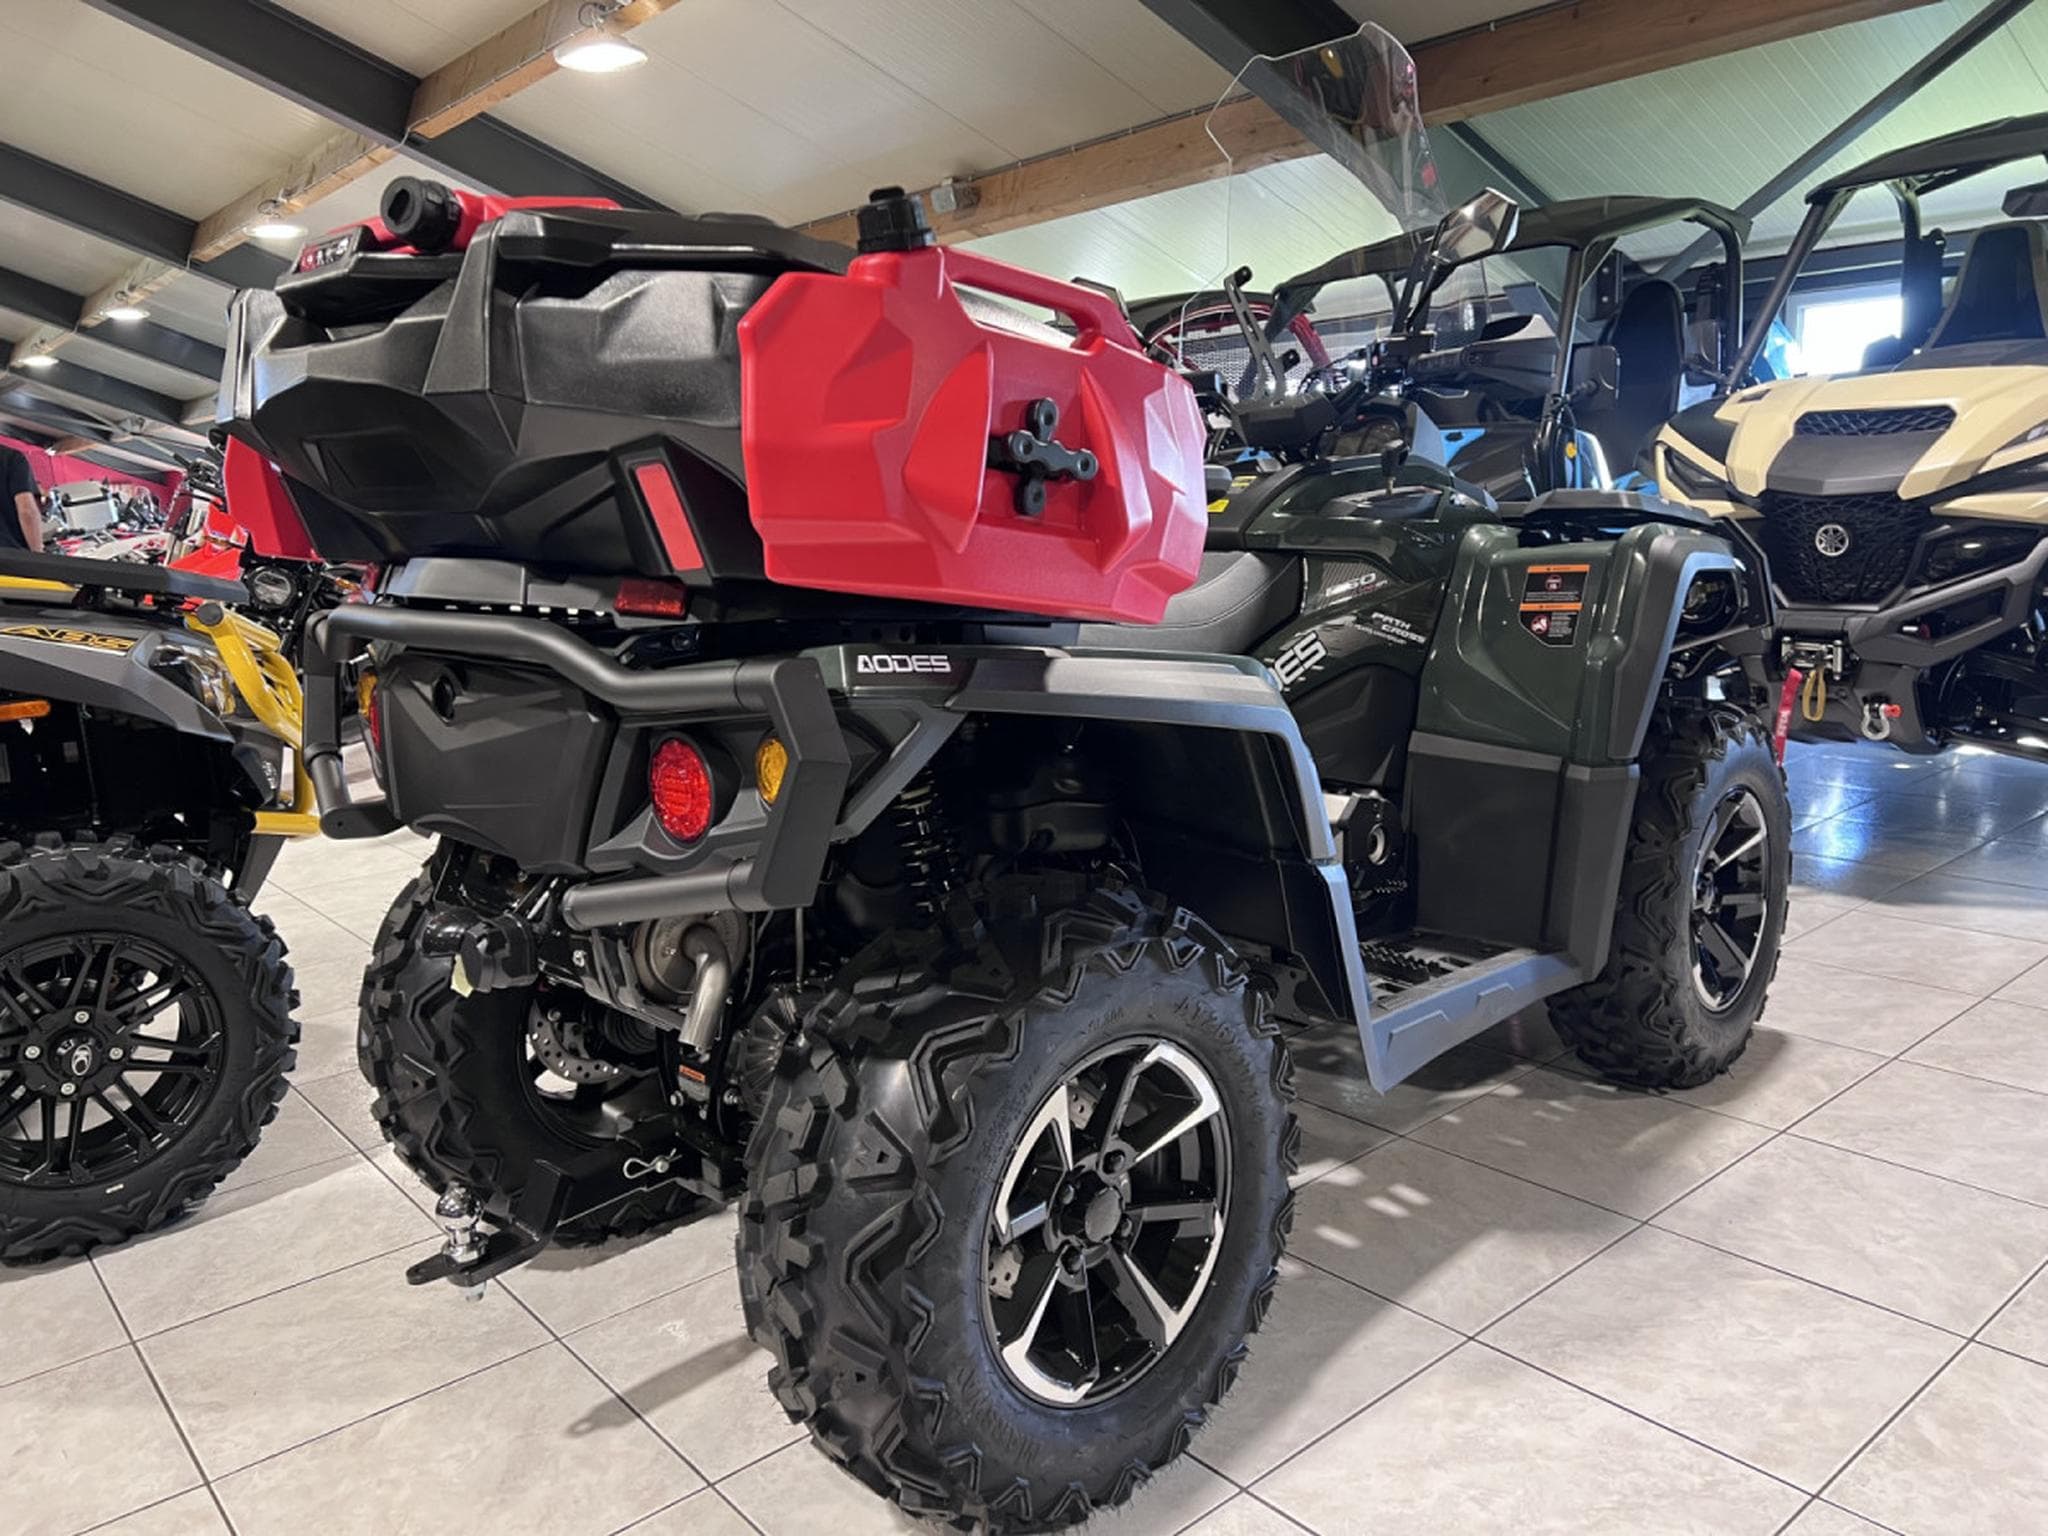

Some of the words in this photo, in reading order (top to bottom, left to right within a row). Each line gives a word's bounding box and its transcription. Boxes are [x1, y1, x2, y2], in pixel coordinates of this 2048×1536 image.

[1371, 611, 1412, 630] PATH
[1381, 624, 1428, 645] CROSS
[857, 654, 952, 673] AODES
[1270, 630, 1328, 690] ES
